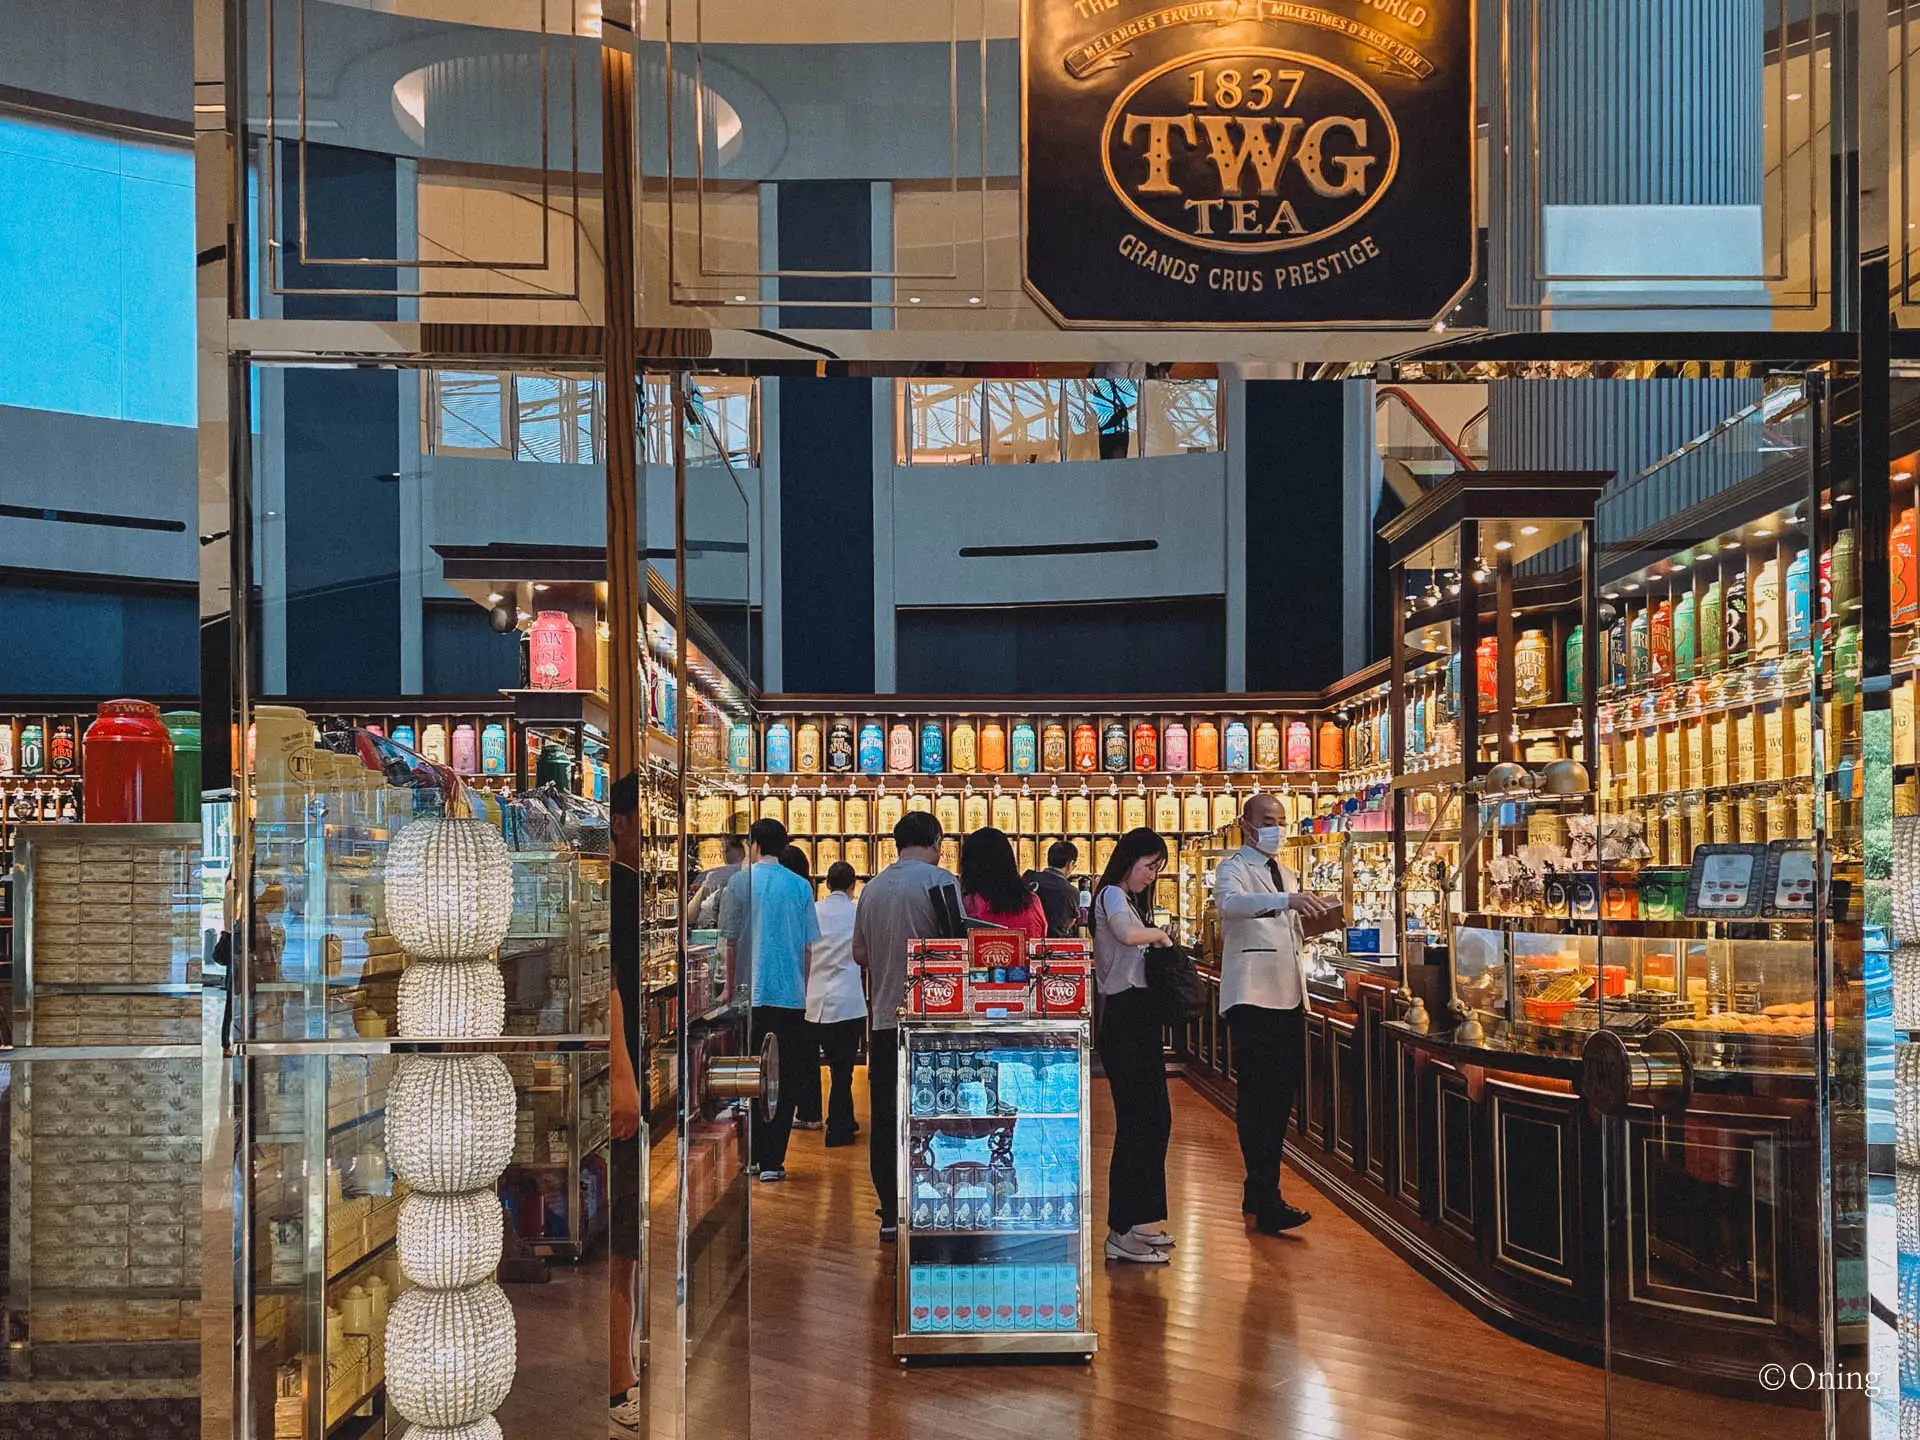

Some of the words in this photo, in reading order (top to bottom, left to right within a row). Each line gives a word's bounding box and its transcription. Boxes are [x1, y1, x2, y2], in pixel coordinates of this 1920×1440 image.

[1362, 0, 1426, 27] ORLD
[1188, 69, 1305, 109] 1837
[1122, 113, 1376, 196] TWG
[1184, 199, 1308, 234] TEA
[1118, 233, 1199, 285] GRANDS
[1208, 267, 1263, 292] CRUS
[1275, 235, 1380, 287] PRESTIGE
[115, 704, 145, 713] TWG
[21, 744, 39, 767] 10
[1530, 833, 1551, 844] TWG
[983, 953, 1010, 964] TWG
[924, 987, 952, 997] TWG
[1048, 987, 1075, 997] TWG
